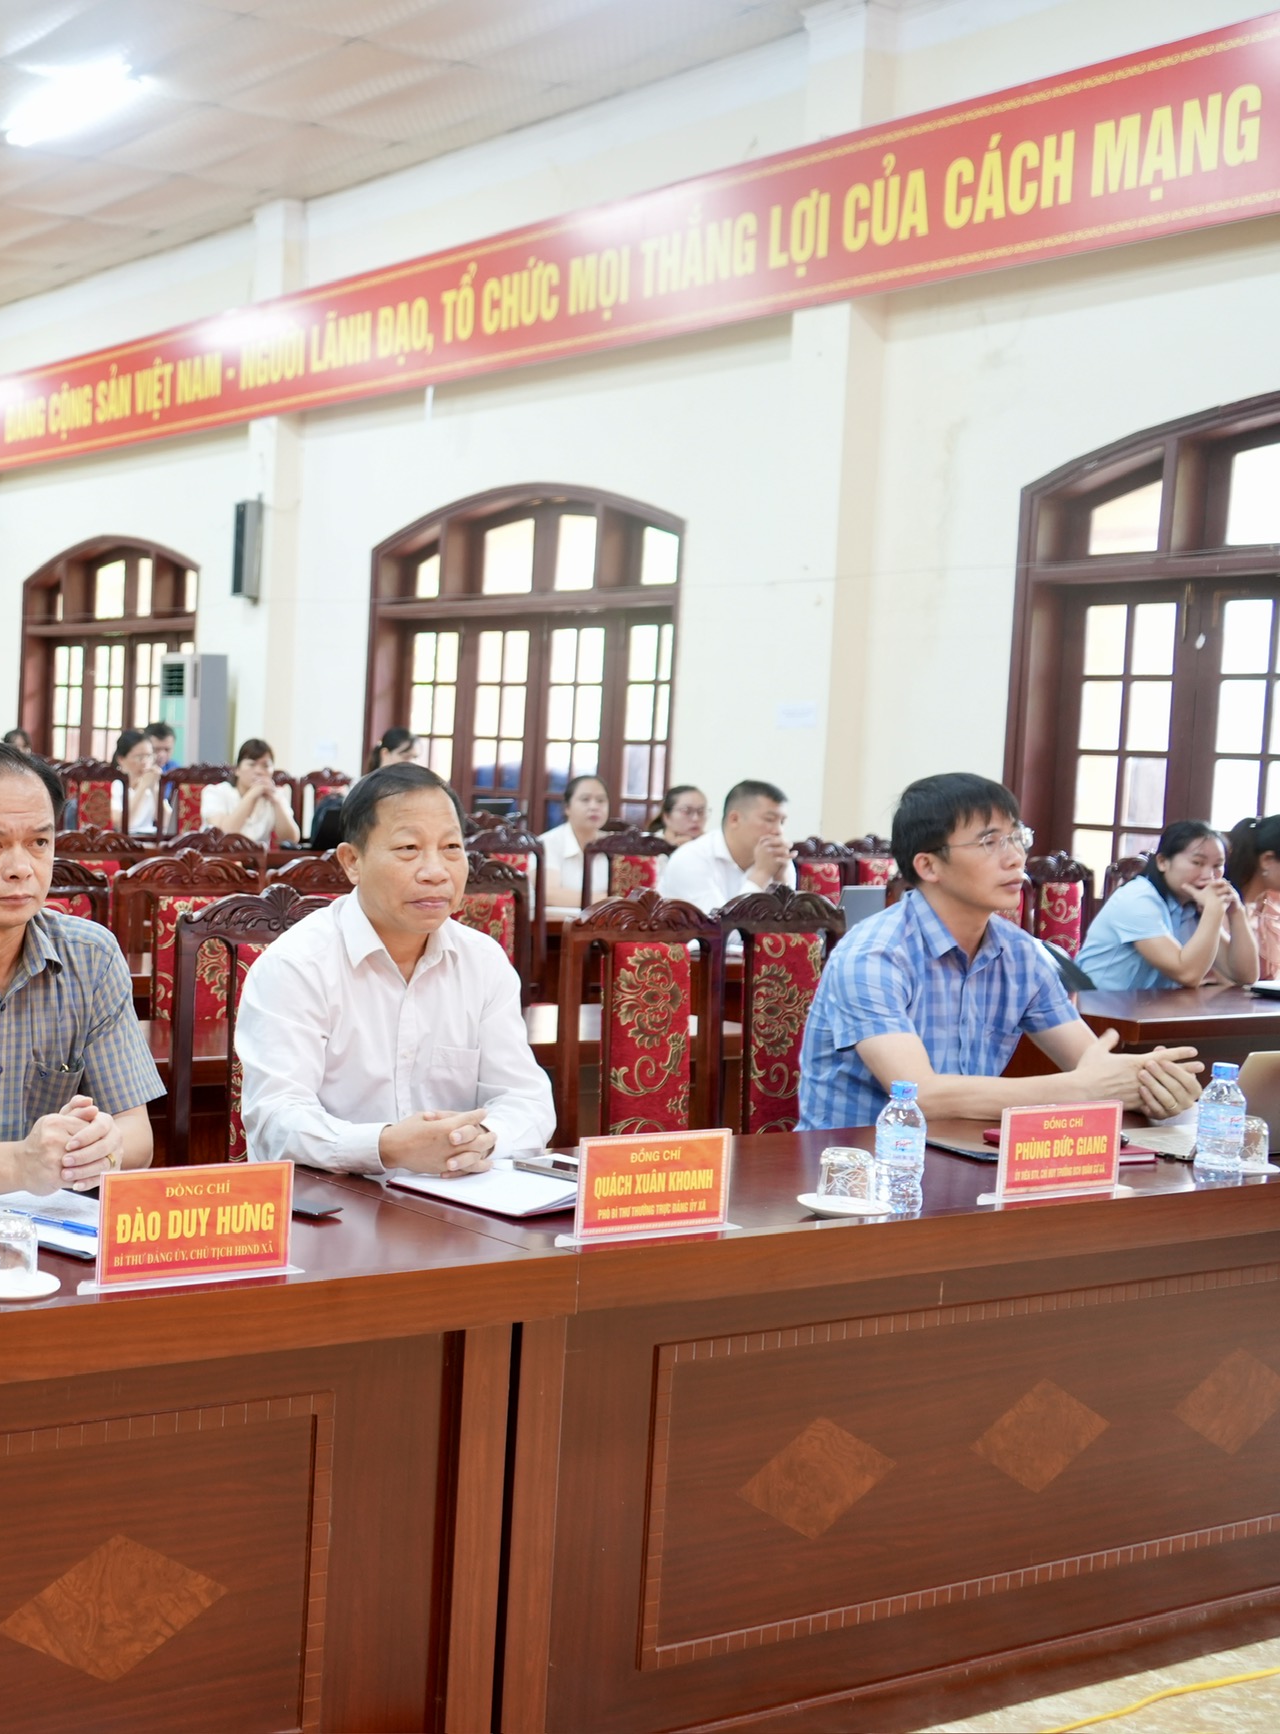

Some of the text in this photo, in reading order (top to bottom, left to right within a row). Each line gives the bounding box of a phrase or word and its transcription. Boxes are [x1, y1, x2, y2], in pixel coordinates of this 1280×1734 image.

[48, 382, 93, 441] CỘNG
[95, 363, 132, 423] SẢN
[135, 356, 174, 420] VIỆT
[176, 352, 222, 405] NAM
[311, 310, 372, 373] LÃNH
[442, 262, 477, 344] TỔ
[482, 256, 560, 335] CHỨC
[568, 245, 631, 321] MỌI
[641, 205, 757, 298] THẮNG
[768, 188, 831, 279] LỢI
[842, 152, 929, 253] CỦA
[943, 132, 1076, 229] CÁCH
[1091, 83, 1263, 202] MẠNG
[1069, 1114, 1084, 1128] CHÍ
[663, 1146, 682, 1161] CHÍ
[1015, 1135, 1108, 1161] PHÙNG ĐỨC GIANG
[206, 1180, 231, 1195] CHÍ
[594, 1168, 714, 1200] QUÁCH XUÂN KHOANH
[116, 1201, 275, 1244] ĐÀO DUY HƯNG
[114, 1252, 124, 1267] BÍ
[125, 1252, 146, 1266] THƯ
[147, 1247, 173, 1264] ĐẢNG
[190, 1245, 209, 1260] CHỦ
[211, 1246, 233, 1260] TỊCH
[234, 1243, 260, 1257] HĐND
[261, 1240, 274, 1254] XÃ
